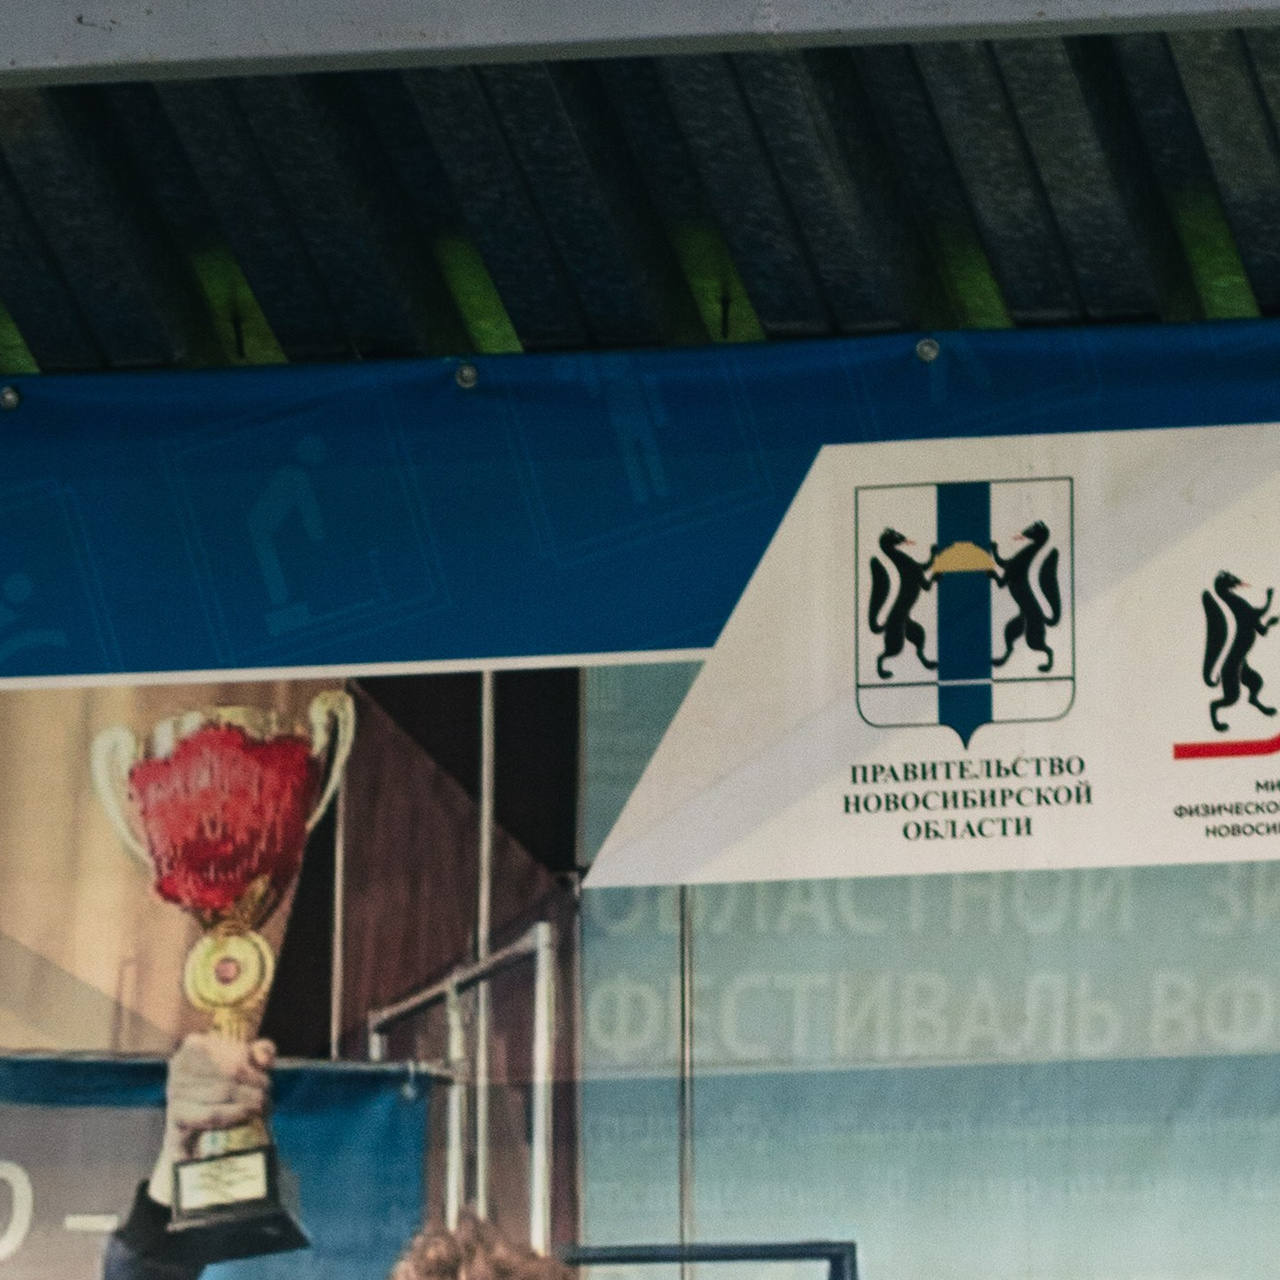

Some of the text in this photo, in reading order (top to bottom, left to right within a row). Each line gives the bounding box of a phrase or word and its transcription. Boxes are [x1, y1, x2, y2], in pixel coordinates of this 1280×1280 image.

[849, 755, 1086, 785] ПРАВИТЕЛЬСТВО
[843, 781, 1093, 815] НОВОСИБИРСКОЙ
[902, 816, 1033, 842] ОБЛАСТИ
[1205, 821, 1280, 838] НОВОСИ
[587, 970, 1122, 1062] ФЕСТИВАЛЬ
